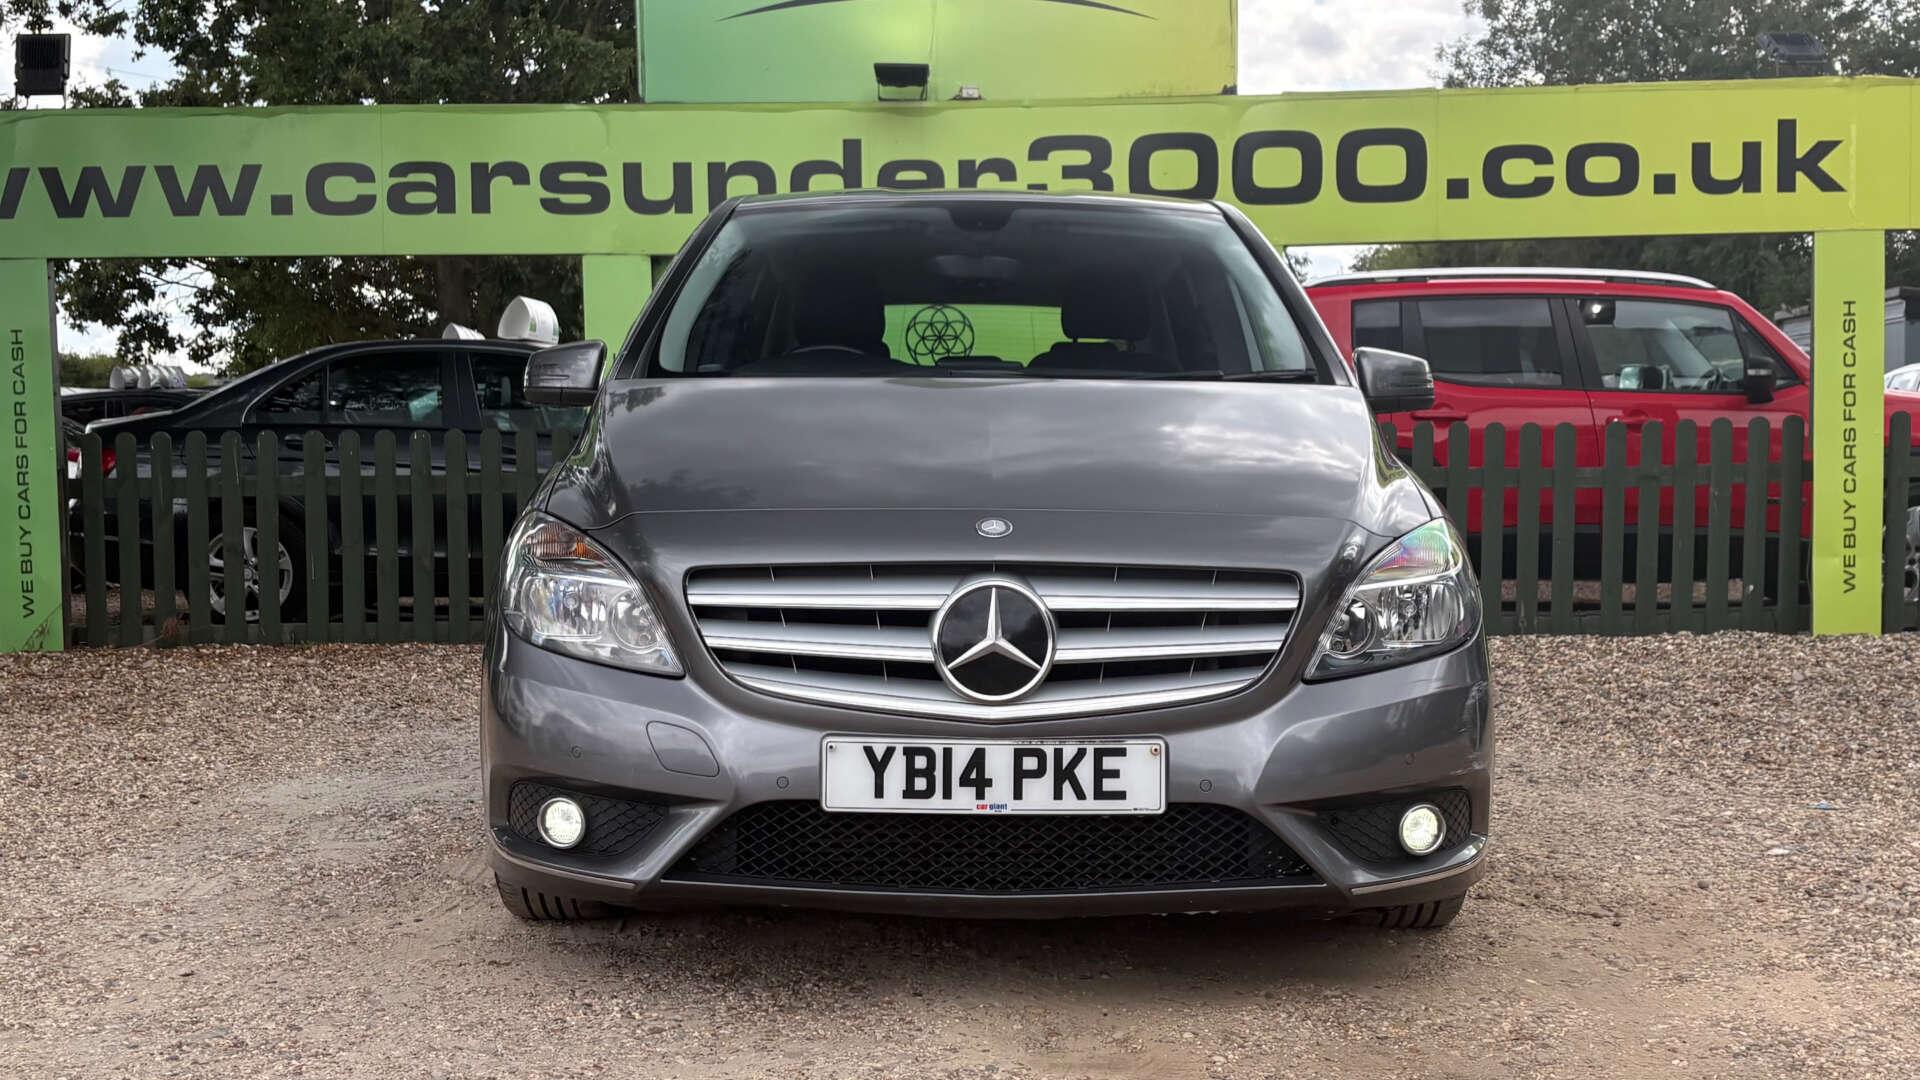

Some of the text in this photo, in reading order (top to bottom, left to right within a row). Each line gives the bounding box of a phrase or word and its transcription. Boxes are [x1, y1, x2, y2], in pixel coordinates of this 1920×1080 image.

[0, 119, 1845, 219] ww.carsunder3000.co.uk
[10, 329, 35, 619] WE BUY CARS FOR CASH
[1842, 300, 1857, 594] WE BUY CARS FOR CASH
[863, 745, 1127, 801] YB14 PKE
